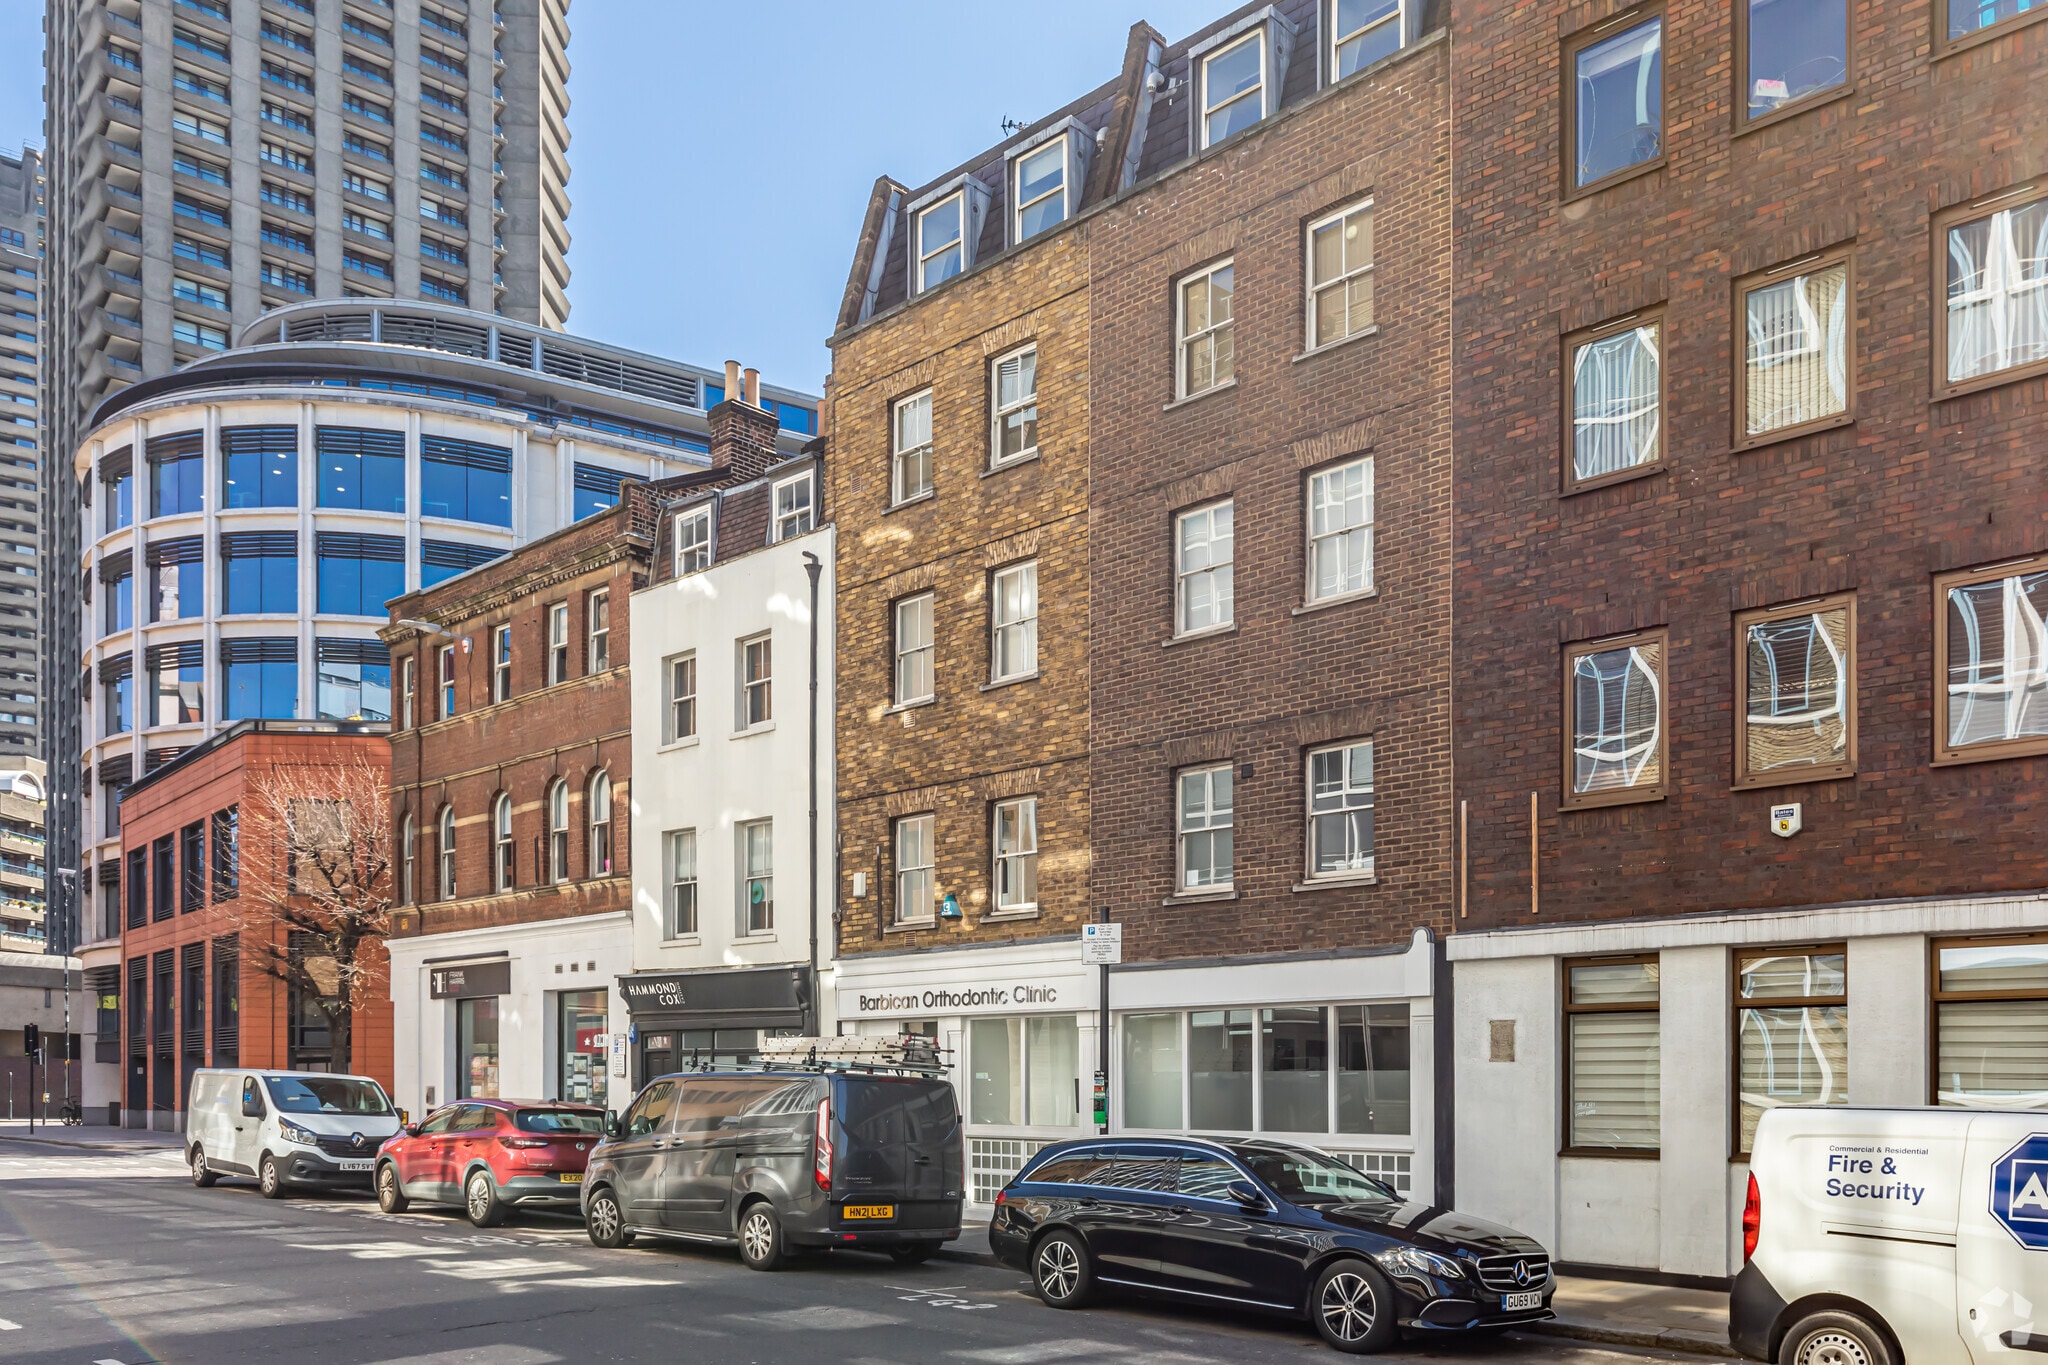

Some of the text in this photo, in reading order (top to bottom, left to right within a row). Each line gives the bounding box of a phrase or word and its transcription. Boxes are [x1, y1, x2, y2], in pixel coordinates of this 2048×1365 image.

[628, 982, 676, 996] HAMMOND
[659, 994, 680, 1005] COX
[859, 985, 1057, 1011] Barbican Orthodontic Clinic
[1829, 1145, 1875, 1153] Commercial
[1884, 1147, 1929, 1155] Residential
[1828, 1155, 1897, 1175] Fire &
[1826, 1178, 1925, 1206] Security
[871, 1207, 888, 1216] LXG
[1508, 1295, 1528, 1307] GU69
